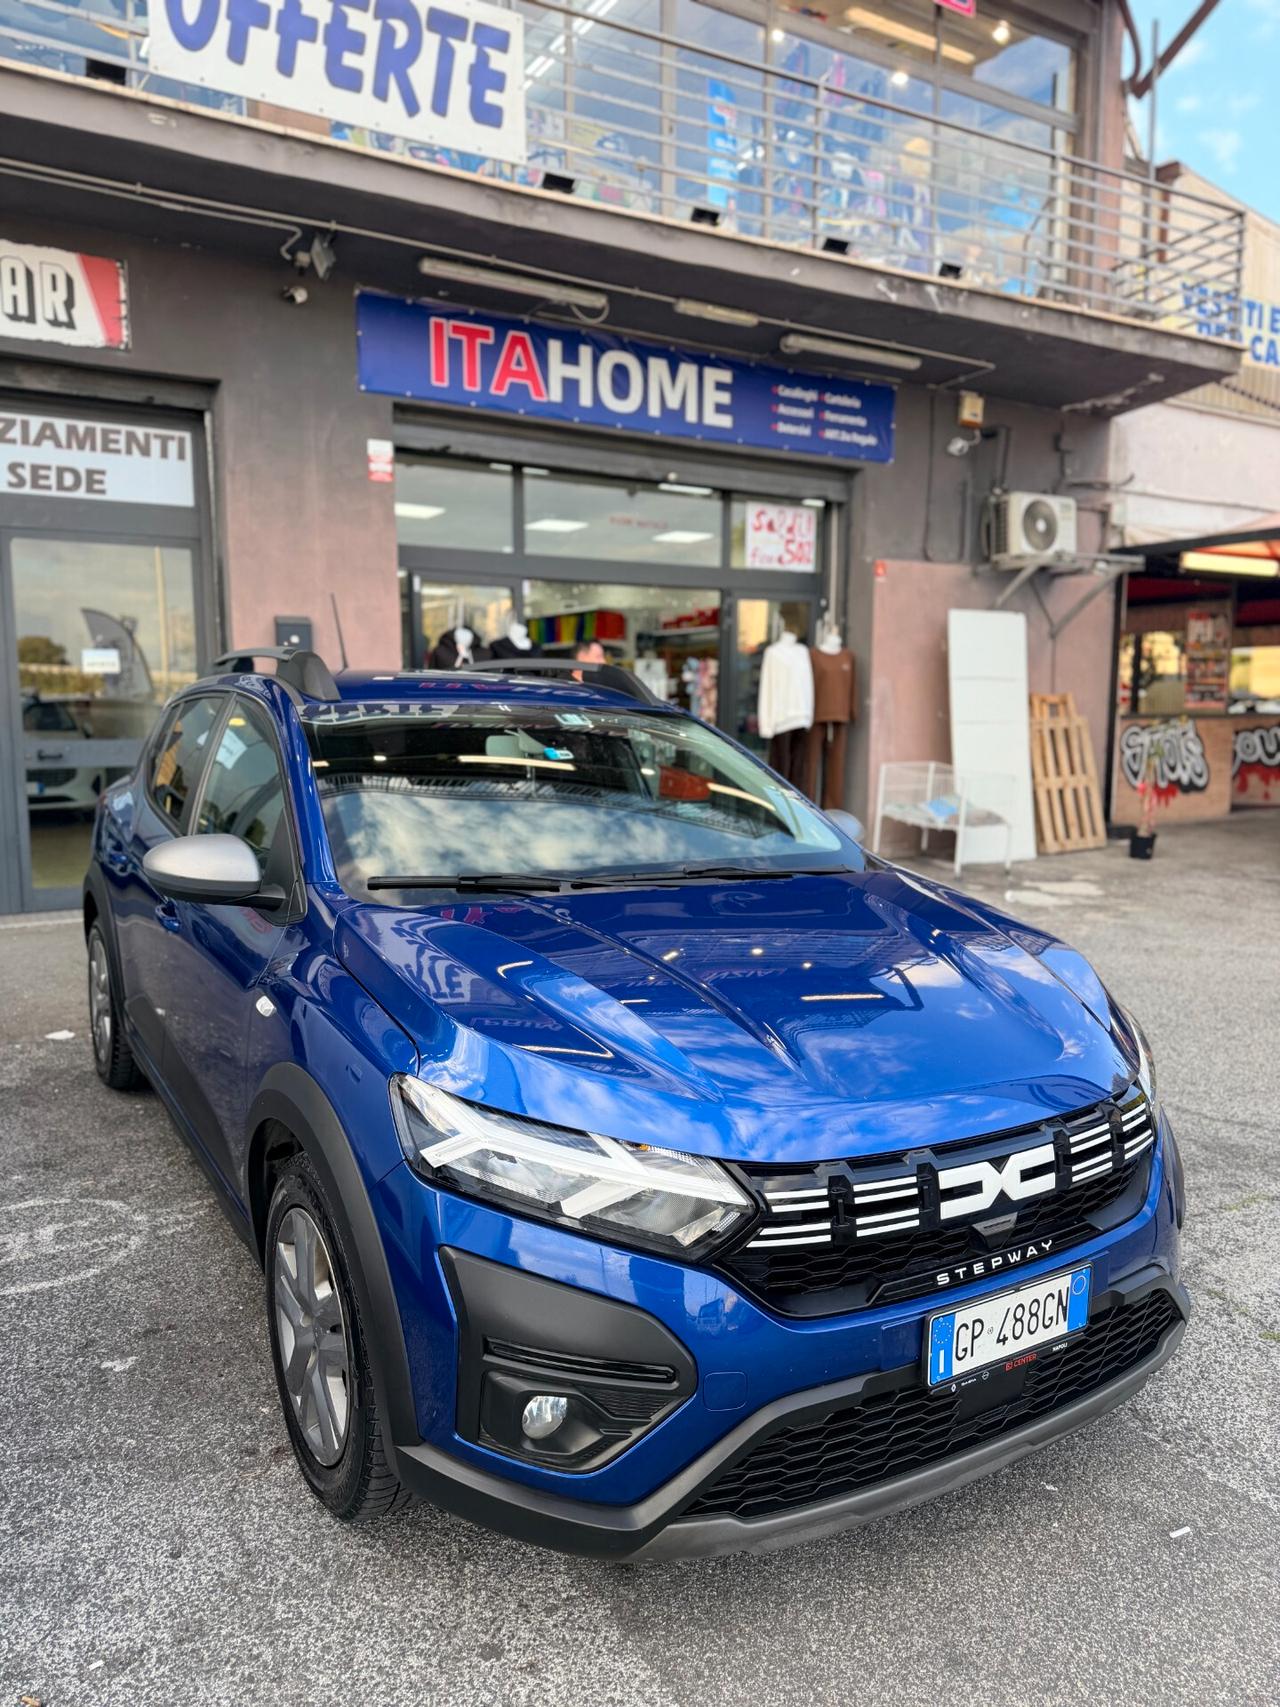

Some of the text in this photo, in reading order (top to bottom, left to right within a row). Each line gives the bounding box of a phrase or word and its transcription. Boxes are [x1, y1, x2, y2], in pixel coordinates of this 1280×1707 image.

[429, 316, 734, 429] ITAHOME
[7, 462, 107, 495] SEDE
[936, 1239, 1053, 1286] STEPWAY
[1013, 1353, 1037, 1368] CENTER
[1052, 1342, 1068, 1353] NAPOLI
